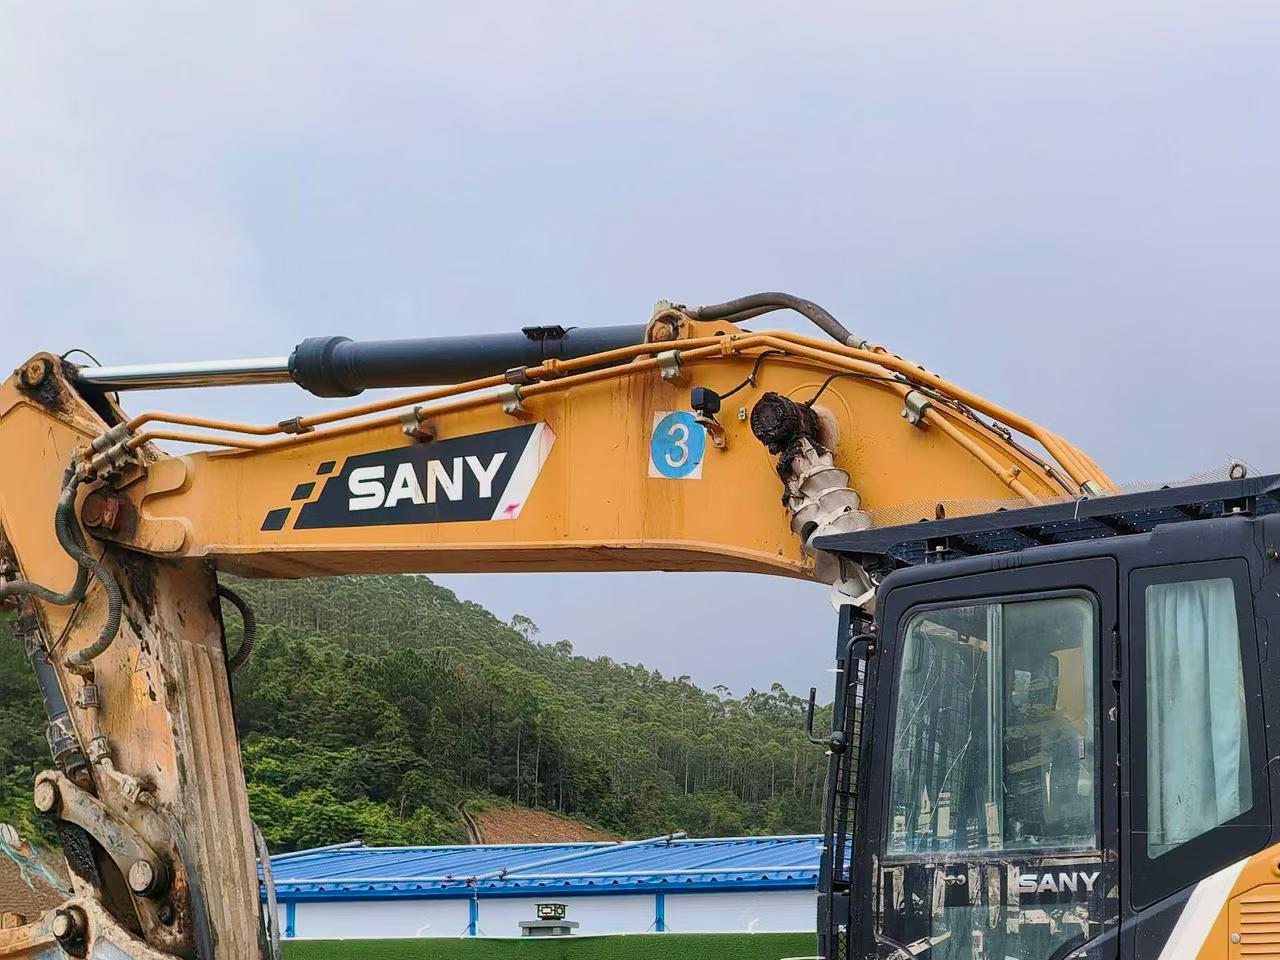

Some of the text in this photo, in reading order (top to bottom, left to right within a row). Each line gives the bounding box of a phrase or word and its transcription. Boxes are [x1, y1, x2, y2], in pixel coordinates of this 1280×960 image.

[664, 422, 690, 468] 3
[347, 452, 509, 511] SANY
[1018, 871, 1100, 893] SANY
